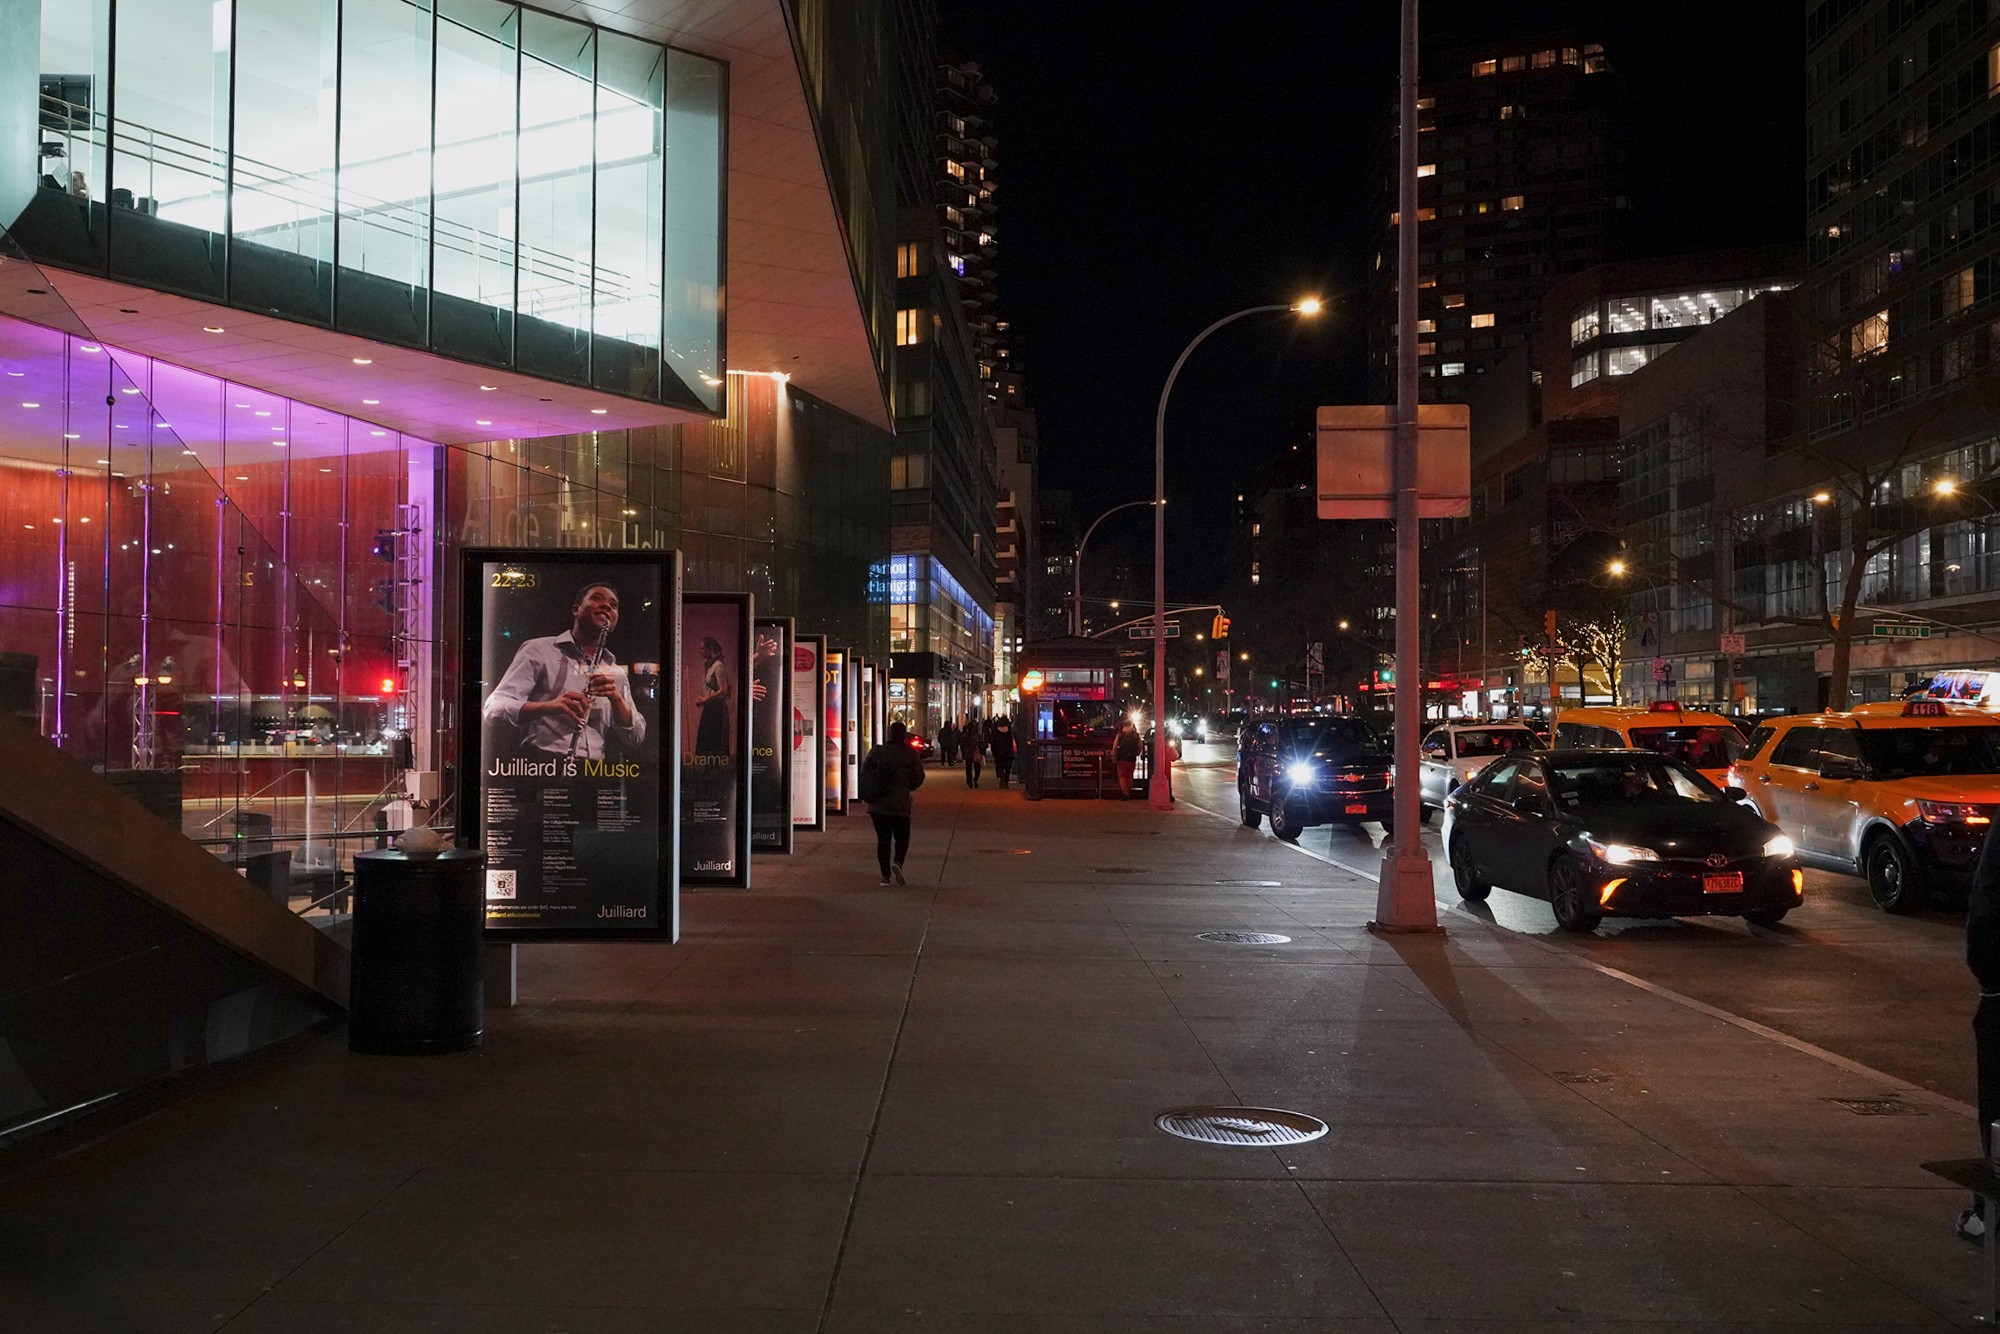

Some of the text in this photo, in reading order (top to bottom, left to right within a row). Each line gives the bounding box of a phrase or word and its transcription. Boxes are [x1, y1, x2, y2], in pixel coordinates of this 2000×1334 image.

[622, 520, 664, 548] Hll
[1886, 627, 1894, 635] W
[1909, 628, 1918, 636] St
[682, 751, 730, 767] Drama
[488, 757, 641, 778] Juilliard is Music
[693, 860, 732, 872] Juilliard
[597, 905, 647, 919] Juilliard
